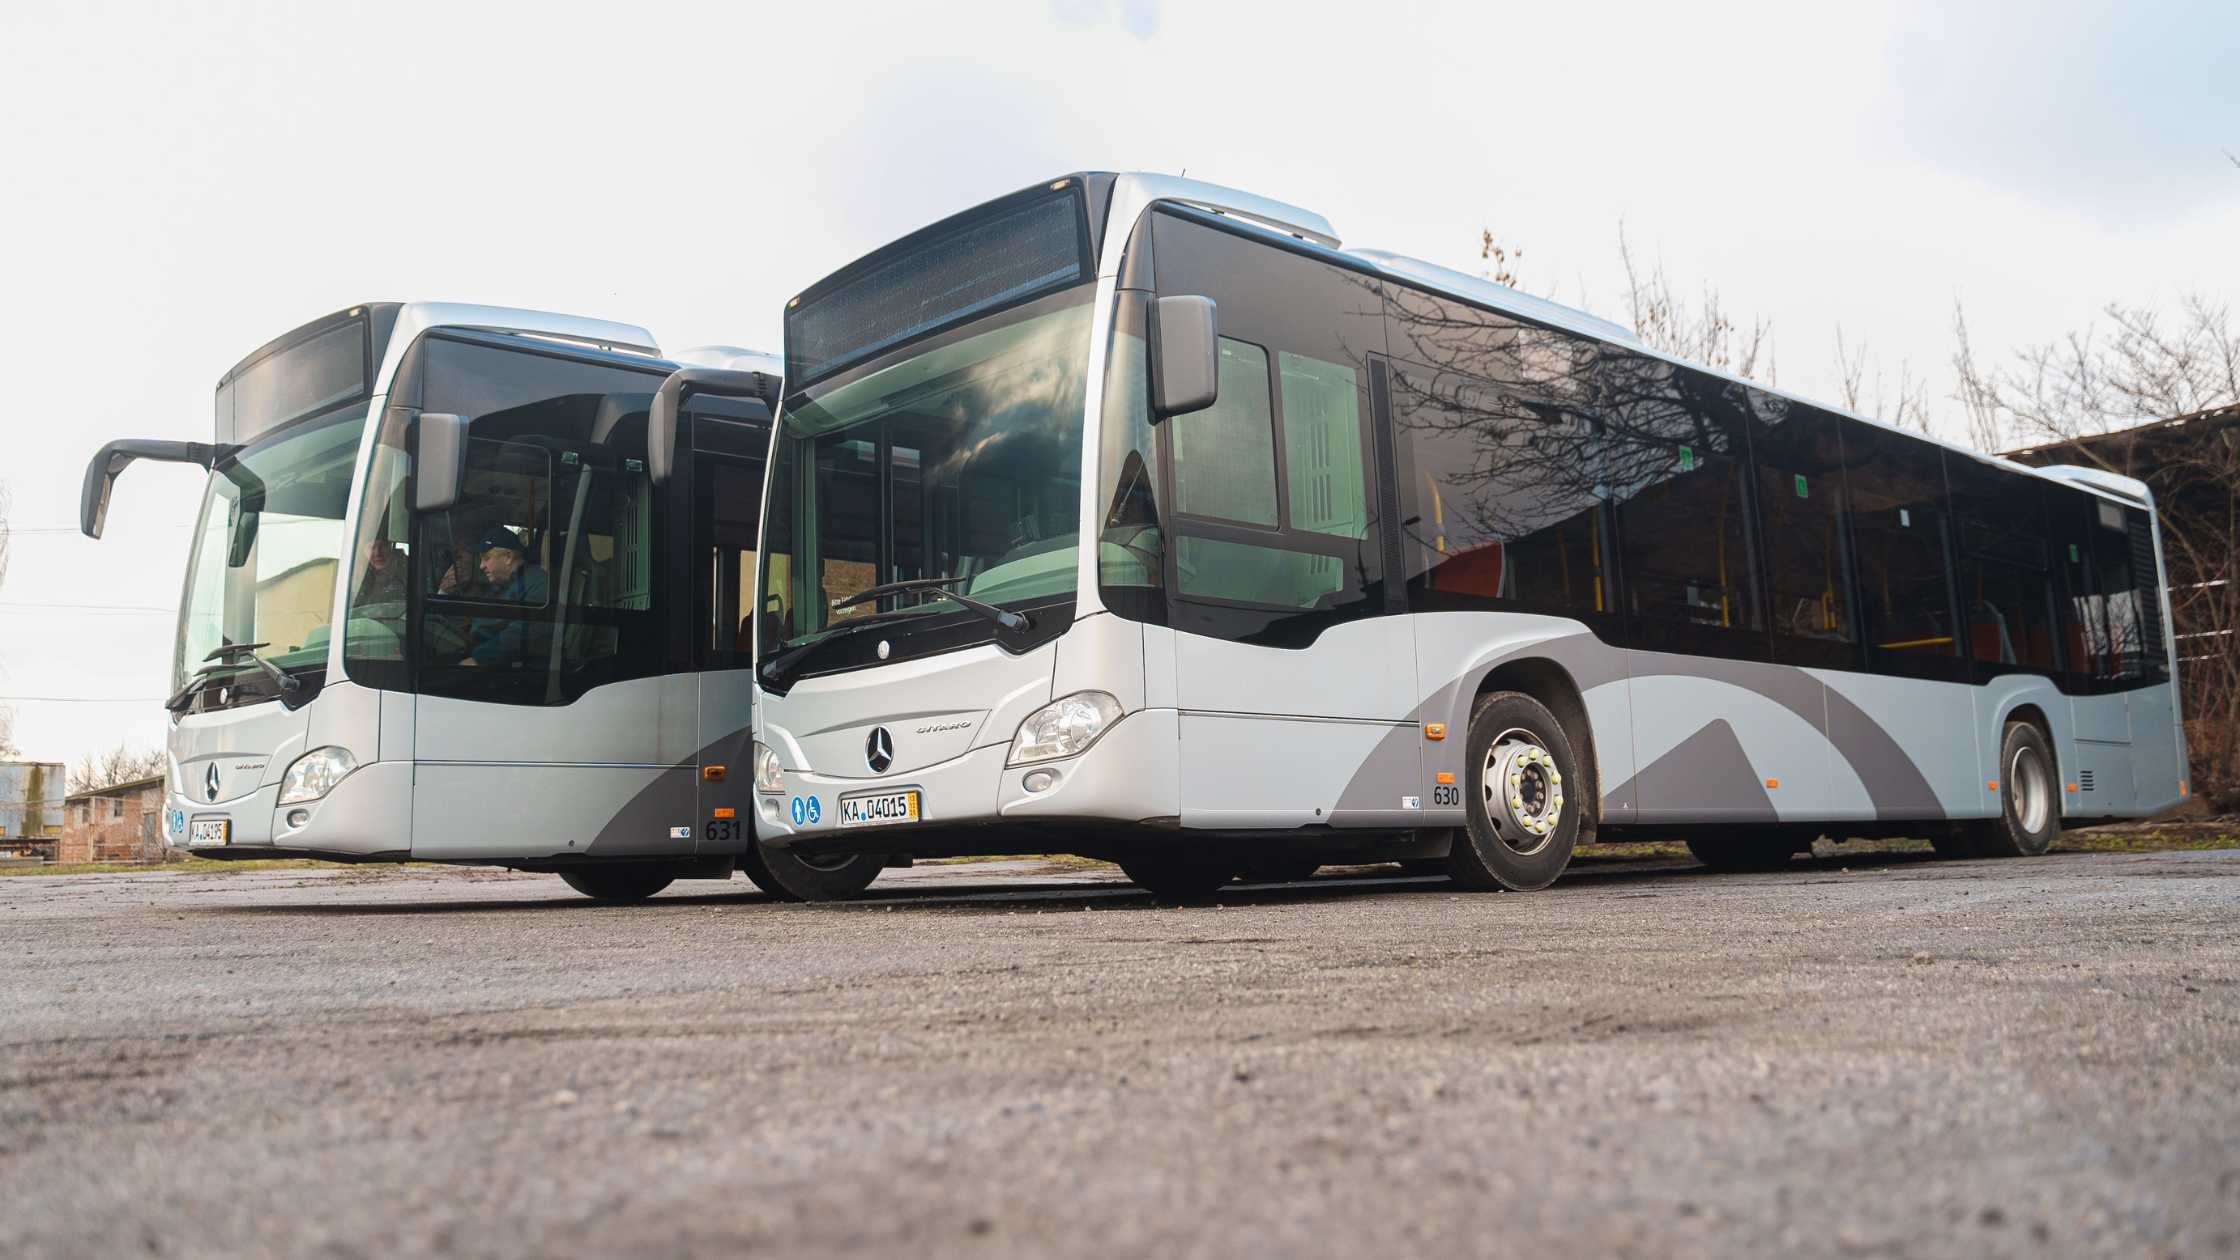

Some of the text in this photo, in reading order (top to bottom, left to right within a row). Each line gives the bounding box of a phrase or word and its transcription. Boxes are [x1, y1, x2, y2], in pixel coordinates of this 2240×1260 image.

[1434, 786, 1459, 806] 630
[843, 801, 860, 821] KA
[867, 796, 907, 819] 04015
[706, 821, 740, 840] 631
